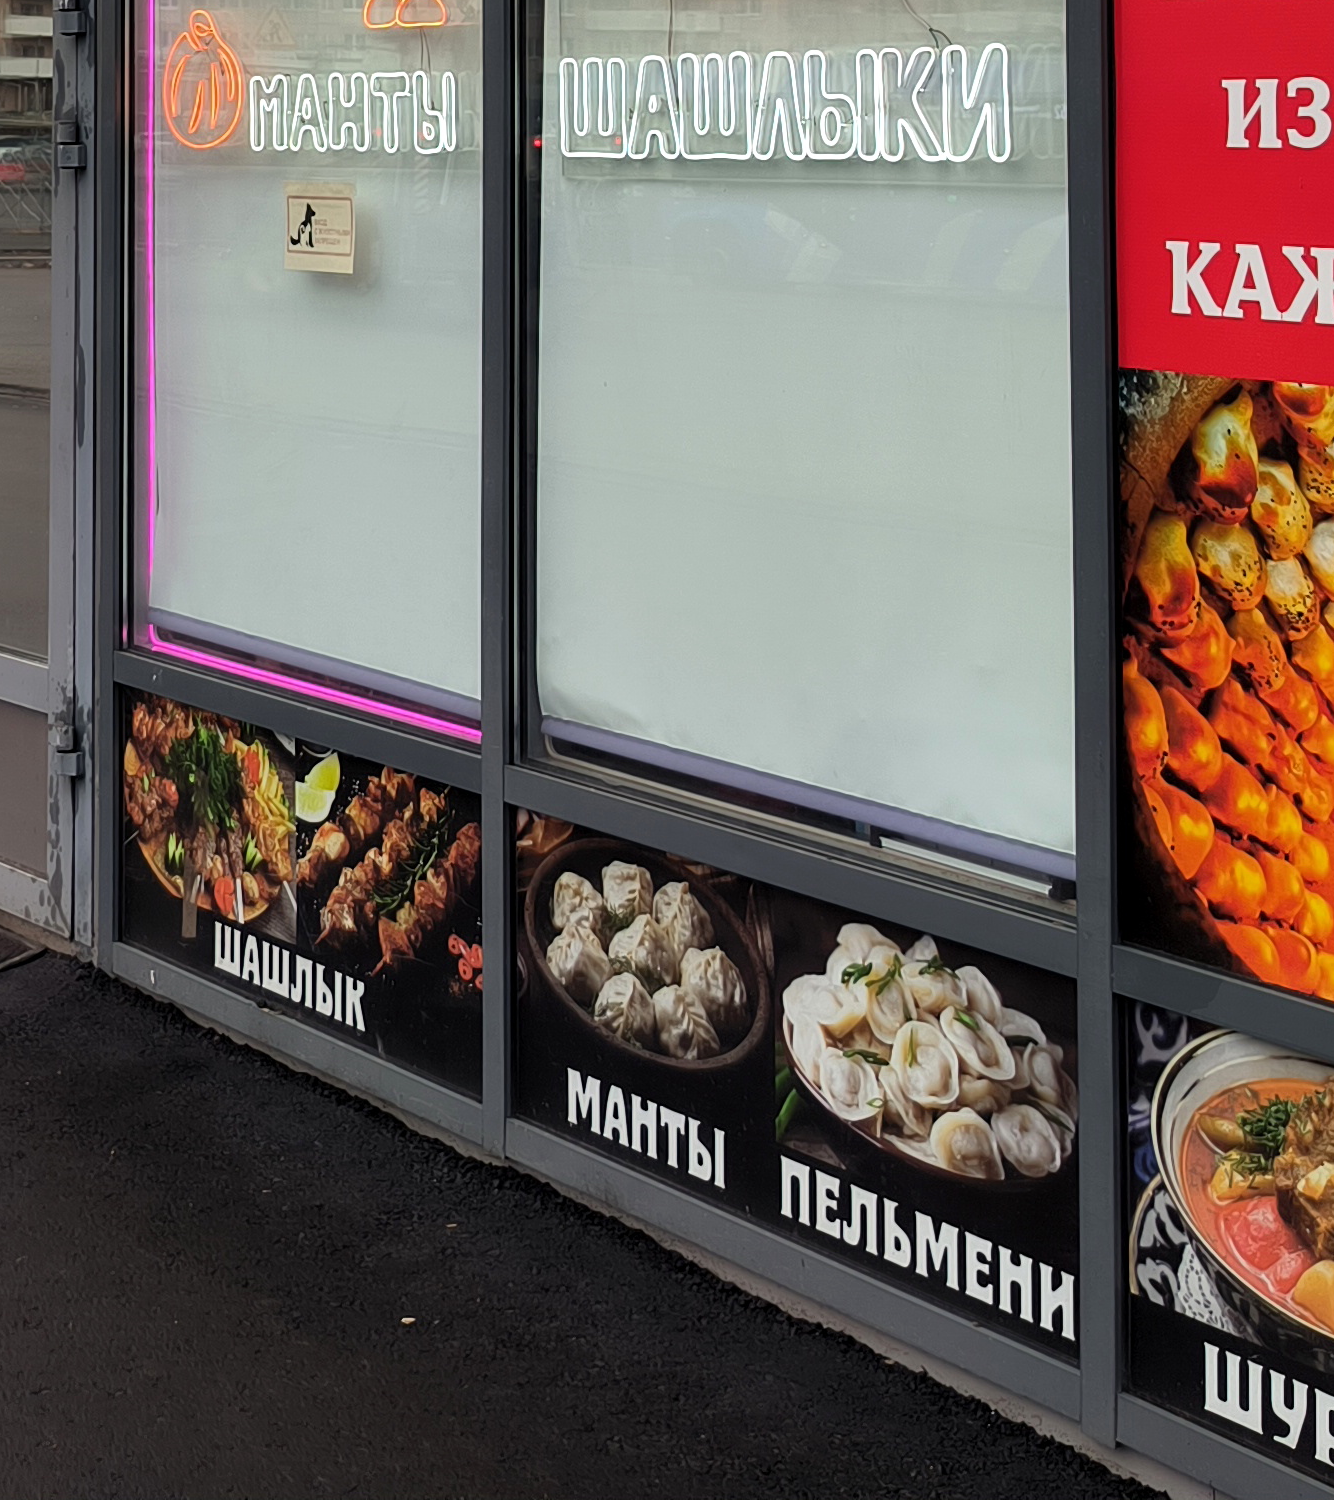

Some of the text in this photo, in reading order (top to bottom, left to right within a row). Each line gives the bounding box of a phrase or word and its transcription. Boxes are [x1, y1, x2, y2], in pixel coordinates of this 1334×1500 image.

[249, 71, 456, 154] МАНТЫ
[559, 43, 1011, 162] ШАШЛЫКИ
[1221, 77, 1332, 150] из
[213, 921, 365, 1033] ШАШЛЫК
[567, 1067, 1076, 1342] МАНТЫ ПЕЛЬМЕНИ
